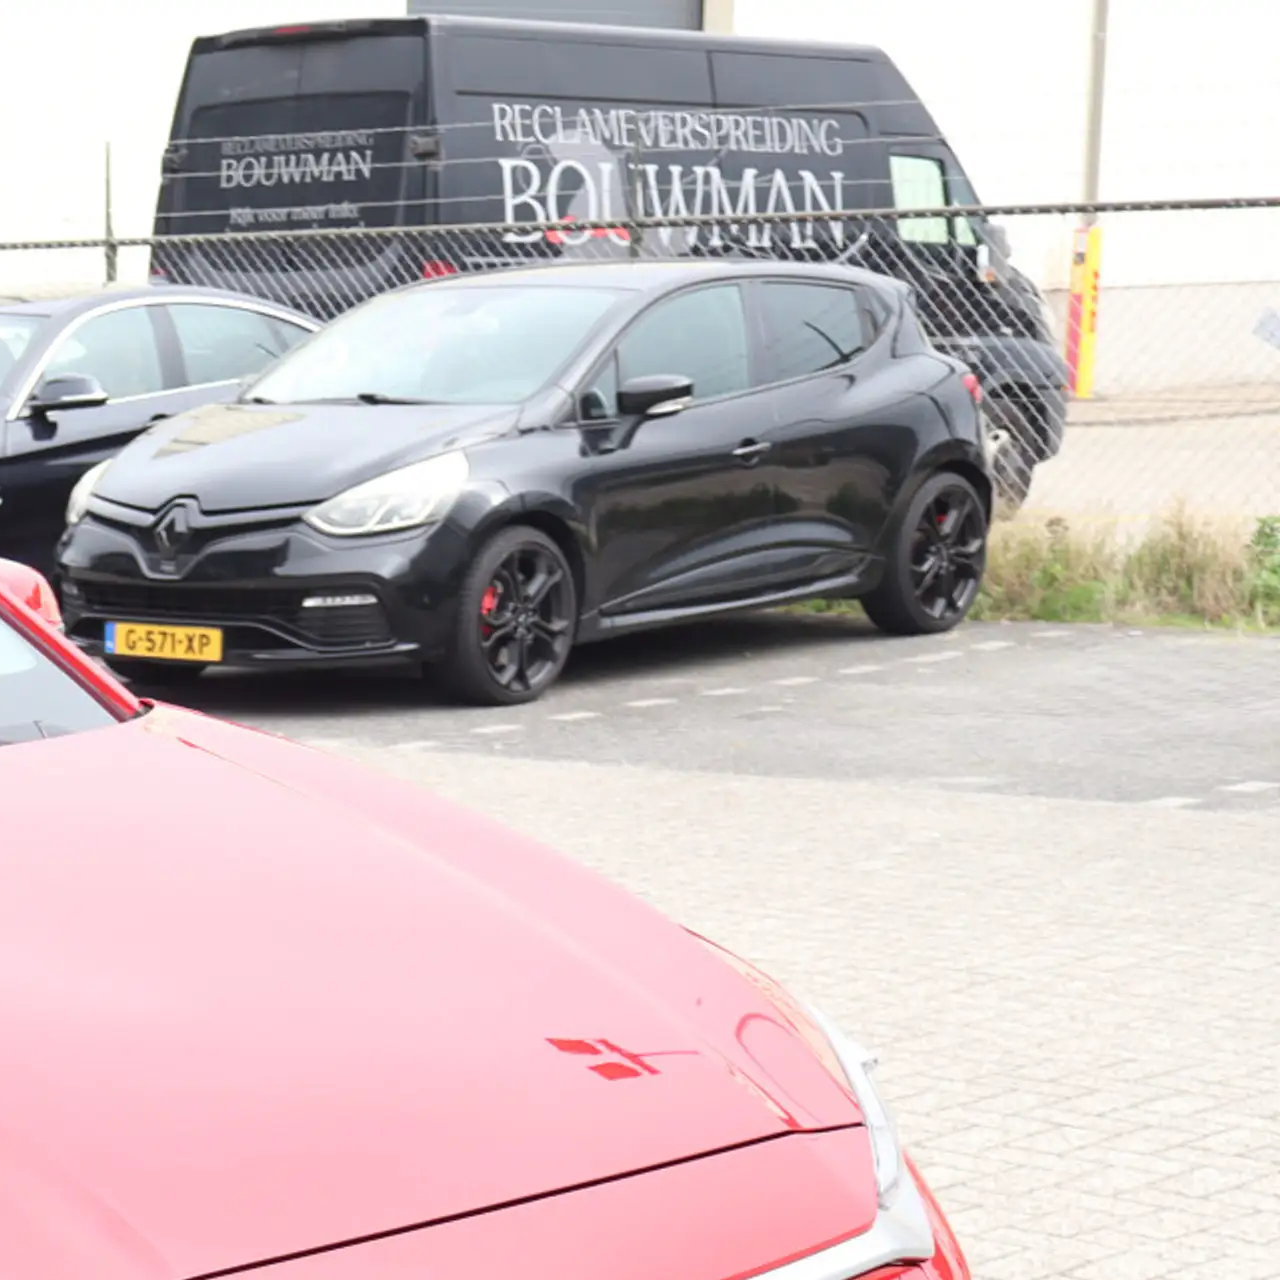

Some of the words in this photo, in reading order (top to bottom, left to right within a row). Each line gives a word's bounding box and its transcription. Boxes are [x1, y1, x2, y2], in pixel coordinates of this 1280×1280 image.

[491, 102, 844, 157] RECLAMEVERSPREIDING
[219, 150, 373, 188] BOUWMAN
[498, 158, 845, 250] BOUWMAN
[124, 628, 212, 656] G-571-XP
